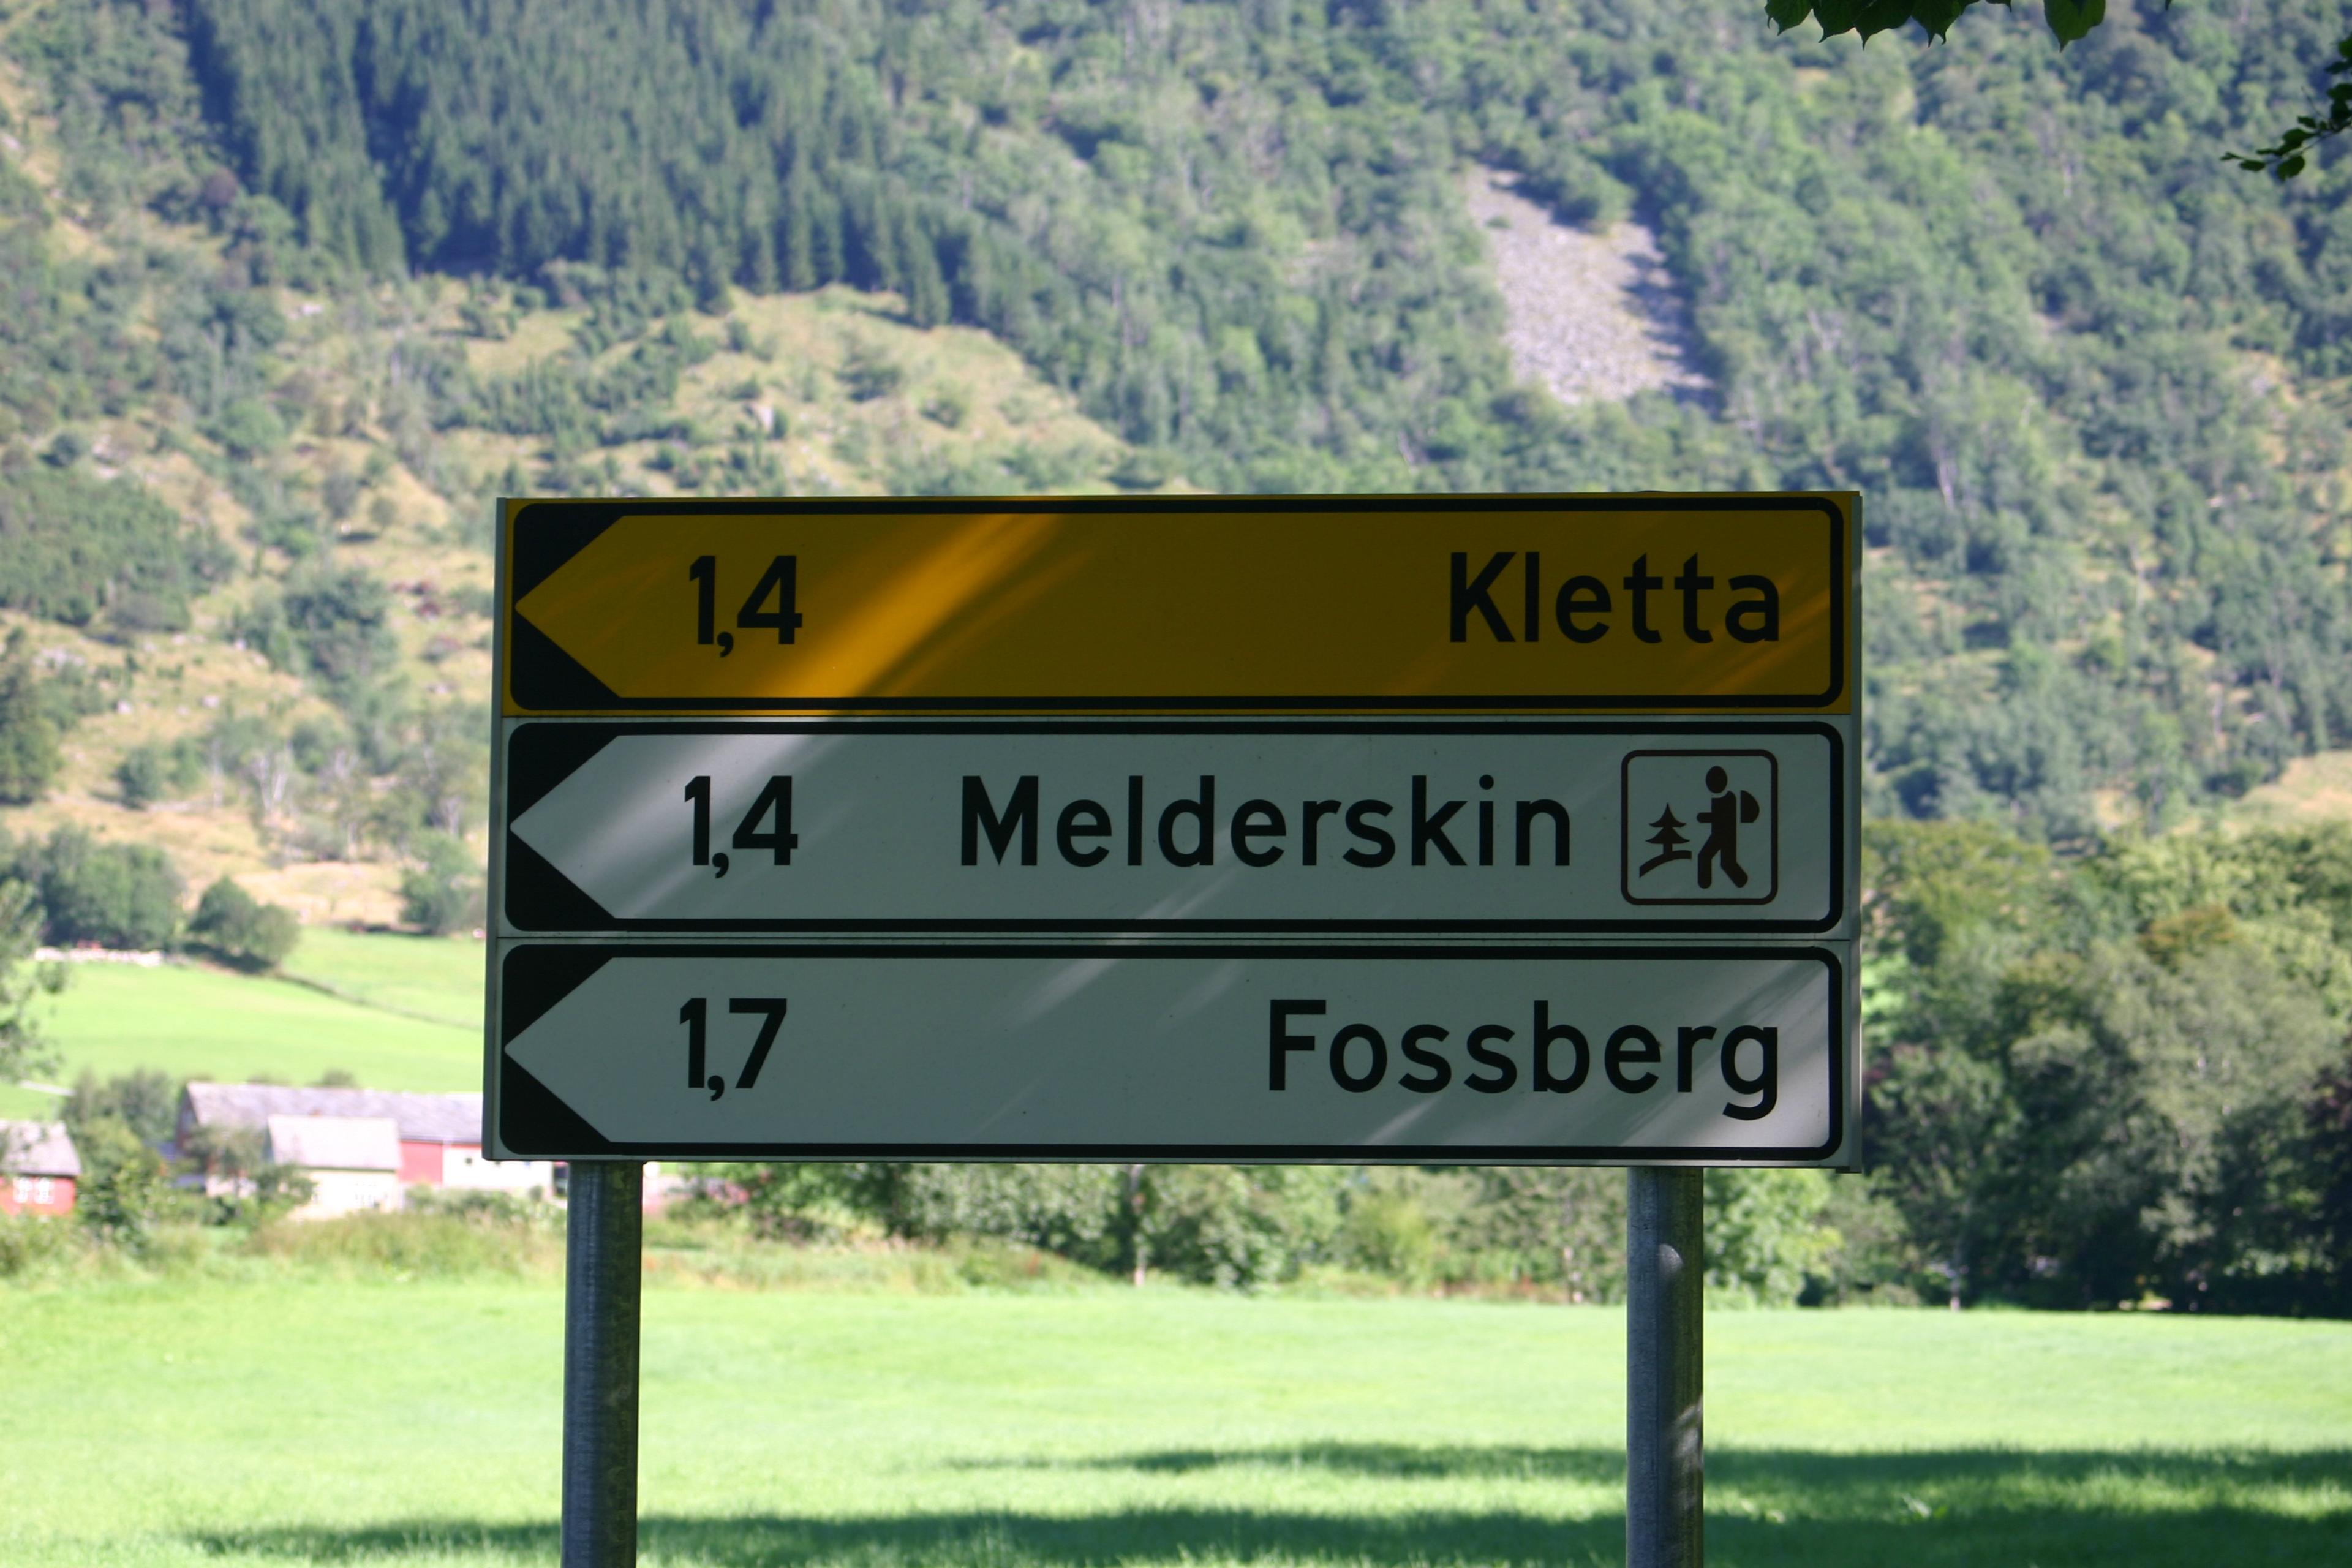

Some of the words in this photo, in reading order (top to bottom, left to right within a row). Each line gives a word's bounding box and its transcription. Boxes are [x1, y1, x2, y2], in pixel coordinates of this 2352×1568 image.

[689, 554, 803, 658] 1,4
[1450, 551, 1779, 644] Kletta
[685, 775, 799, 879] 1,4
[961, 774, 1570, 869] Melderskin
[679, 997, 787, 1102] 1,7
[1269, 999, 1778, 1121] Fossberg
